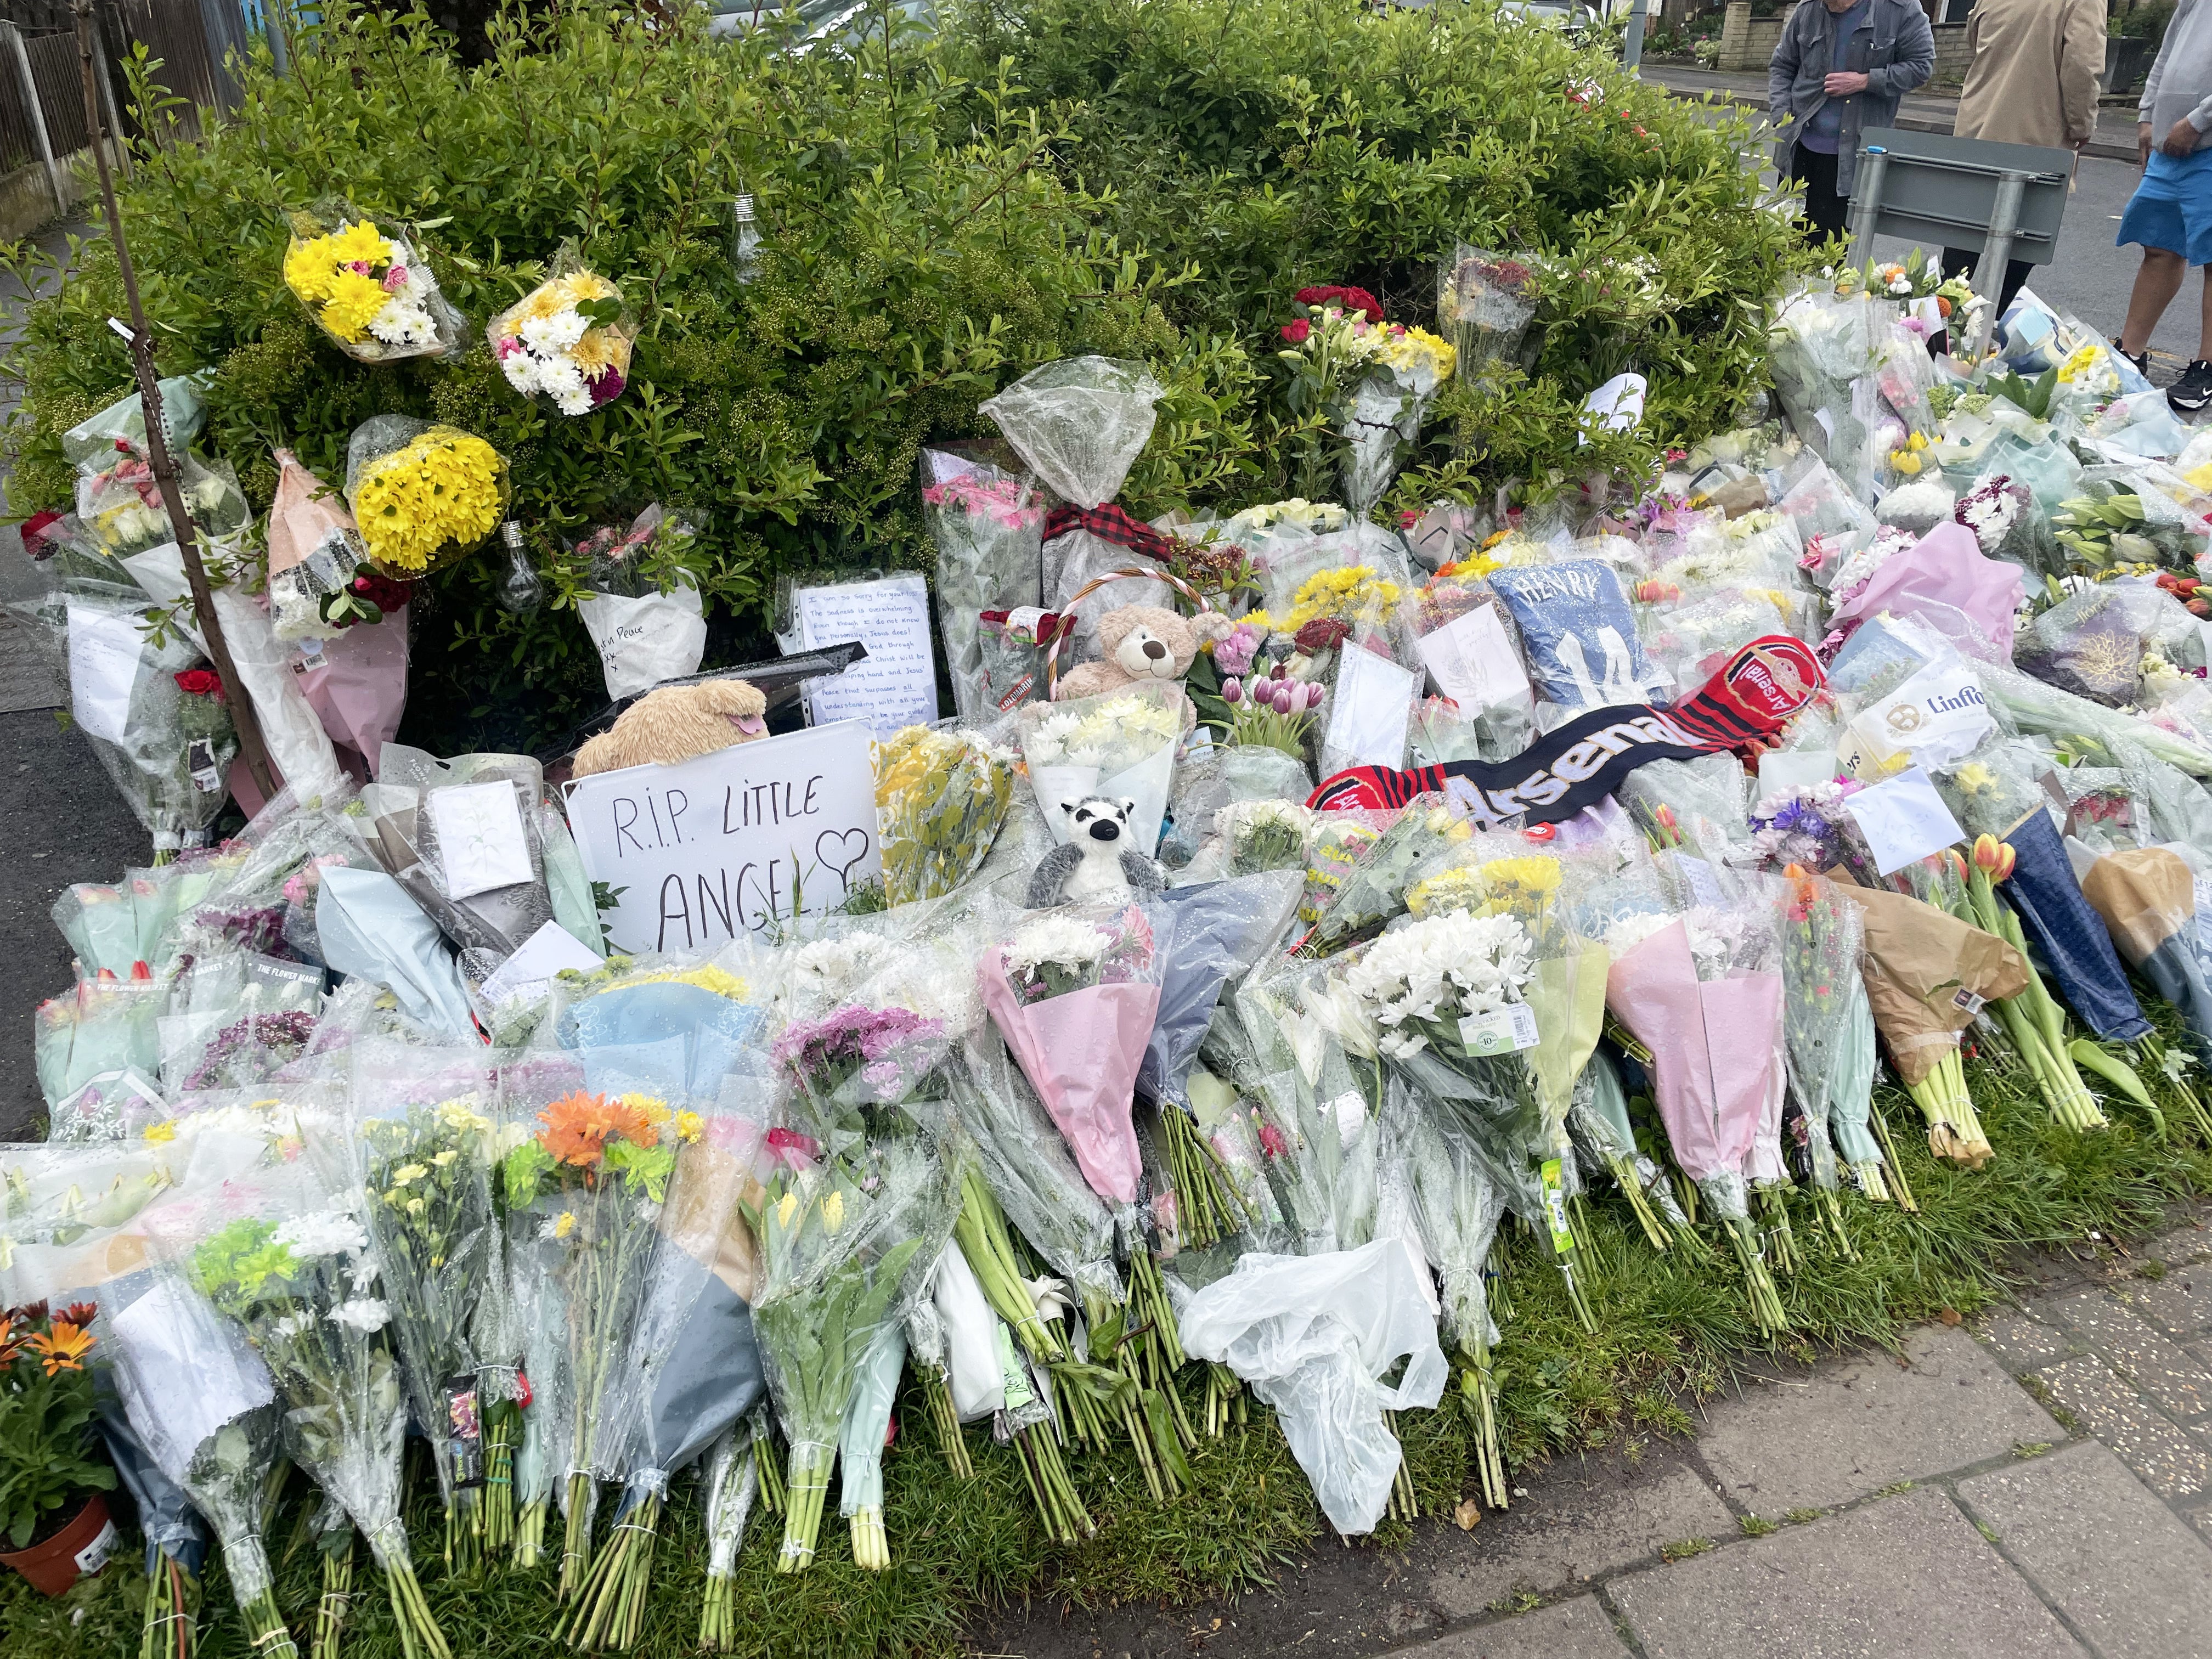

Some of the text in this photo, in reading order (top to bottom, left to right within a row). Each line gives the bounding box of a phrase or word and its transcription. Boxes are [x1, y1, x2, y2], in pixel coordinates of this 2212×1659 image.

[1511, 568, 1597, 607] HENRY
[889, 591, 905, 600] your
[837, 620, 859, 629] though
[608, 636, 614, 645] in
[814, 635, 826, 644] you
[891, 627, 911, 635] does!
[1740, 664, 1792, 710] Arsenal
[825, 699, 874, 709] understanding
[409, 759, 430, 786] FLOWER
[409, 768, 421, 782] SHOP
[1442, 710, 1709, 828] Arsenal
[195, 963, 223, 976] MARKET
[257, 963, 270, 974] THE
[271, 967, 298, 980] FLOWER
